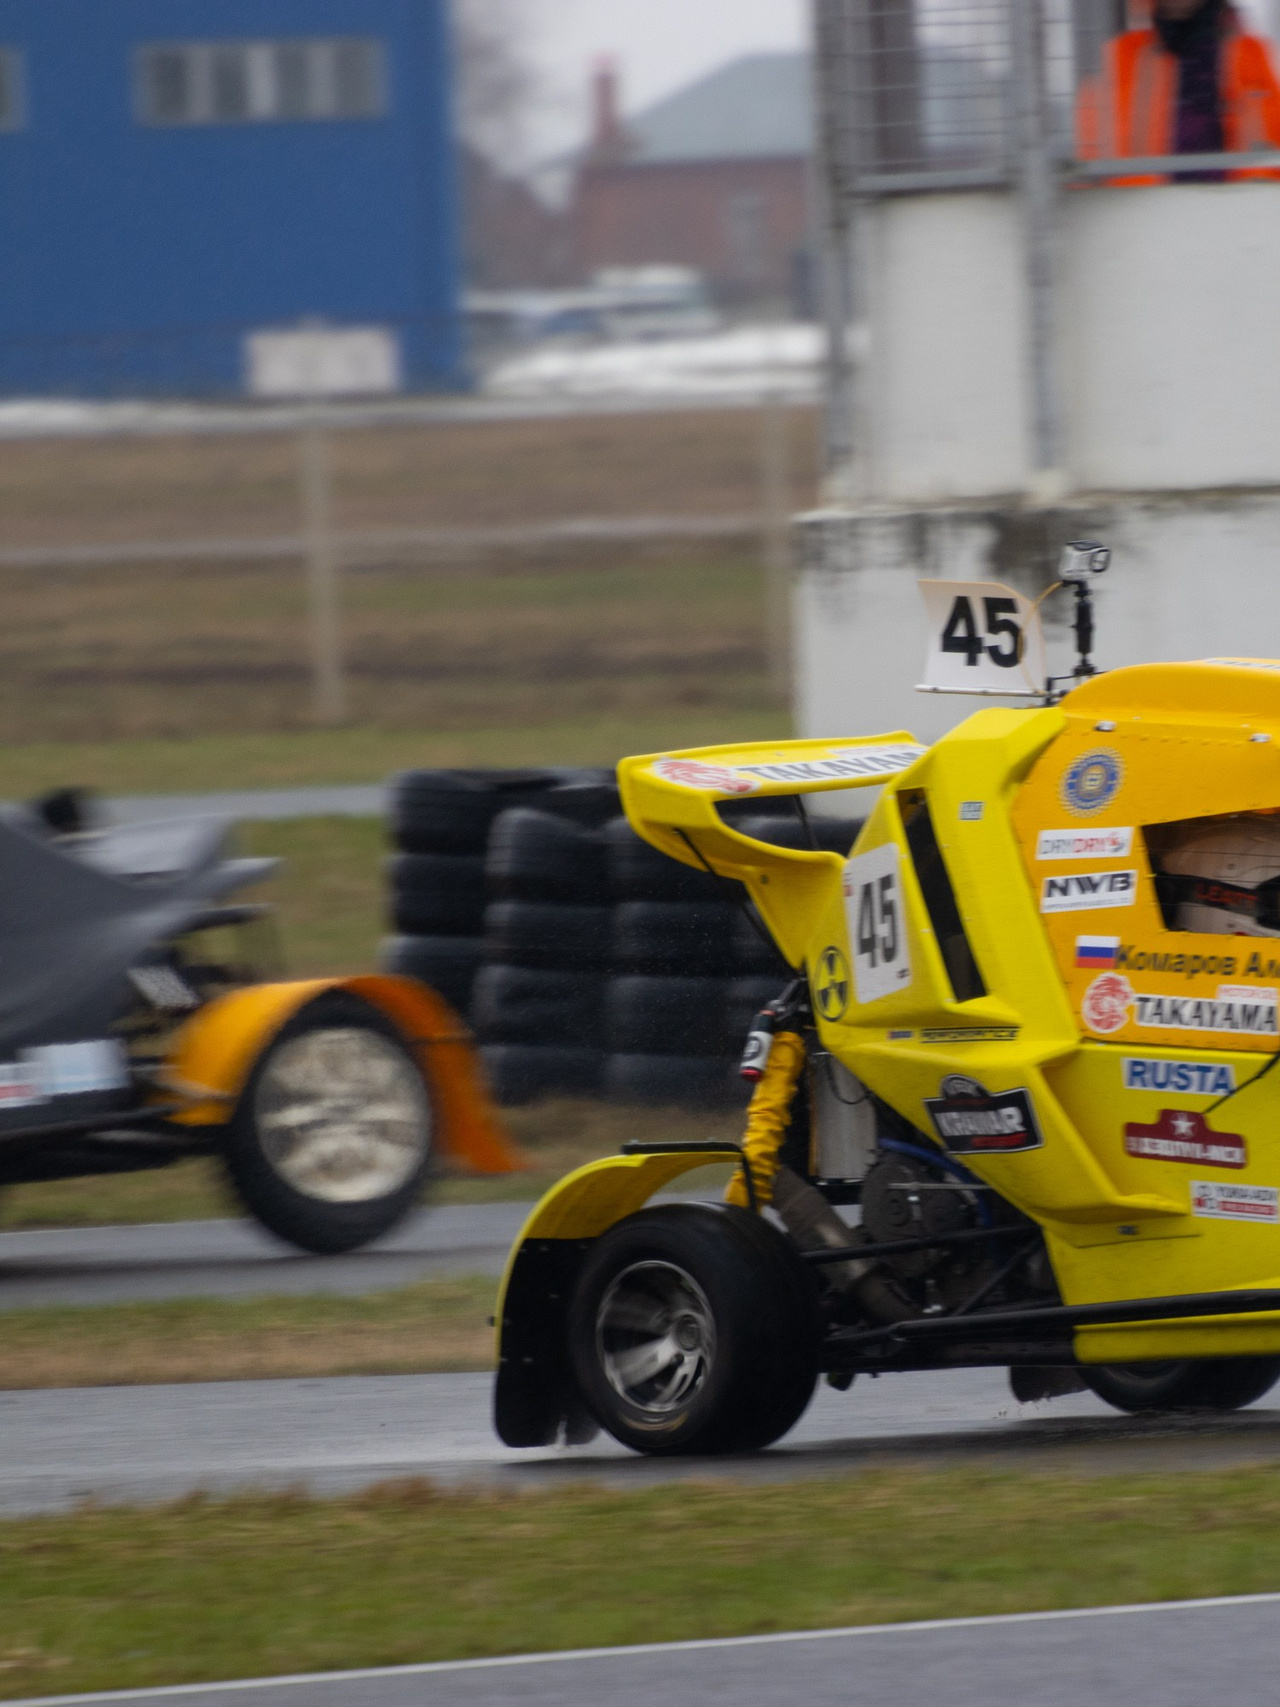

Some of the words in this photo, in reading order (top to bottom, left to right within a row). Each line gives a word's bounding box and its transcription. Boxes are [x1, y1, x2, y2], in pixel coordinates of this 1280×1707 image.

[941, 596, 1023, 668] 45
[736, 751, 926, 781] TAKAYAM
[1045, 872, 1131, 898] NWB
[857, 873, 897, 968] 45
[1116, 943, 1237, 979] Комаров
[1135, 996, 1280, 1032] TAKAYAMA
[1127, 1060, 1236, 1094] RUSTA
